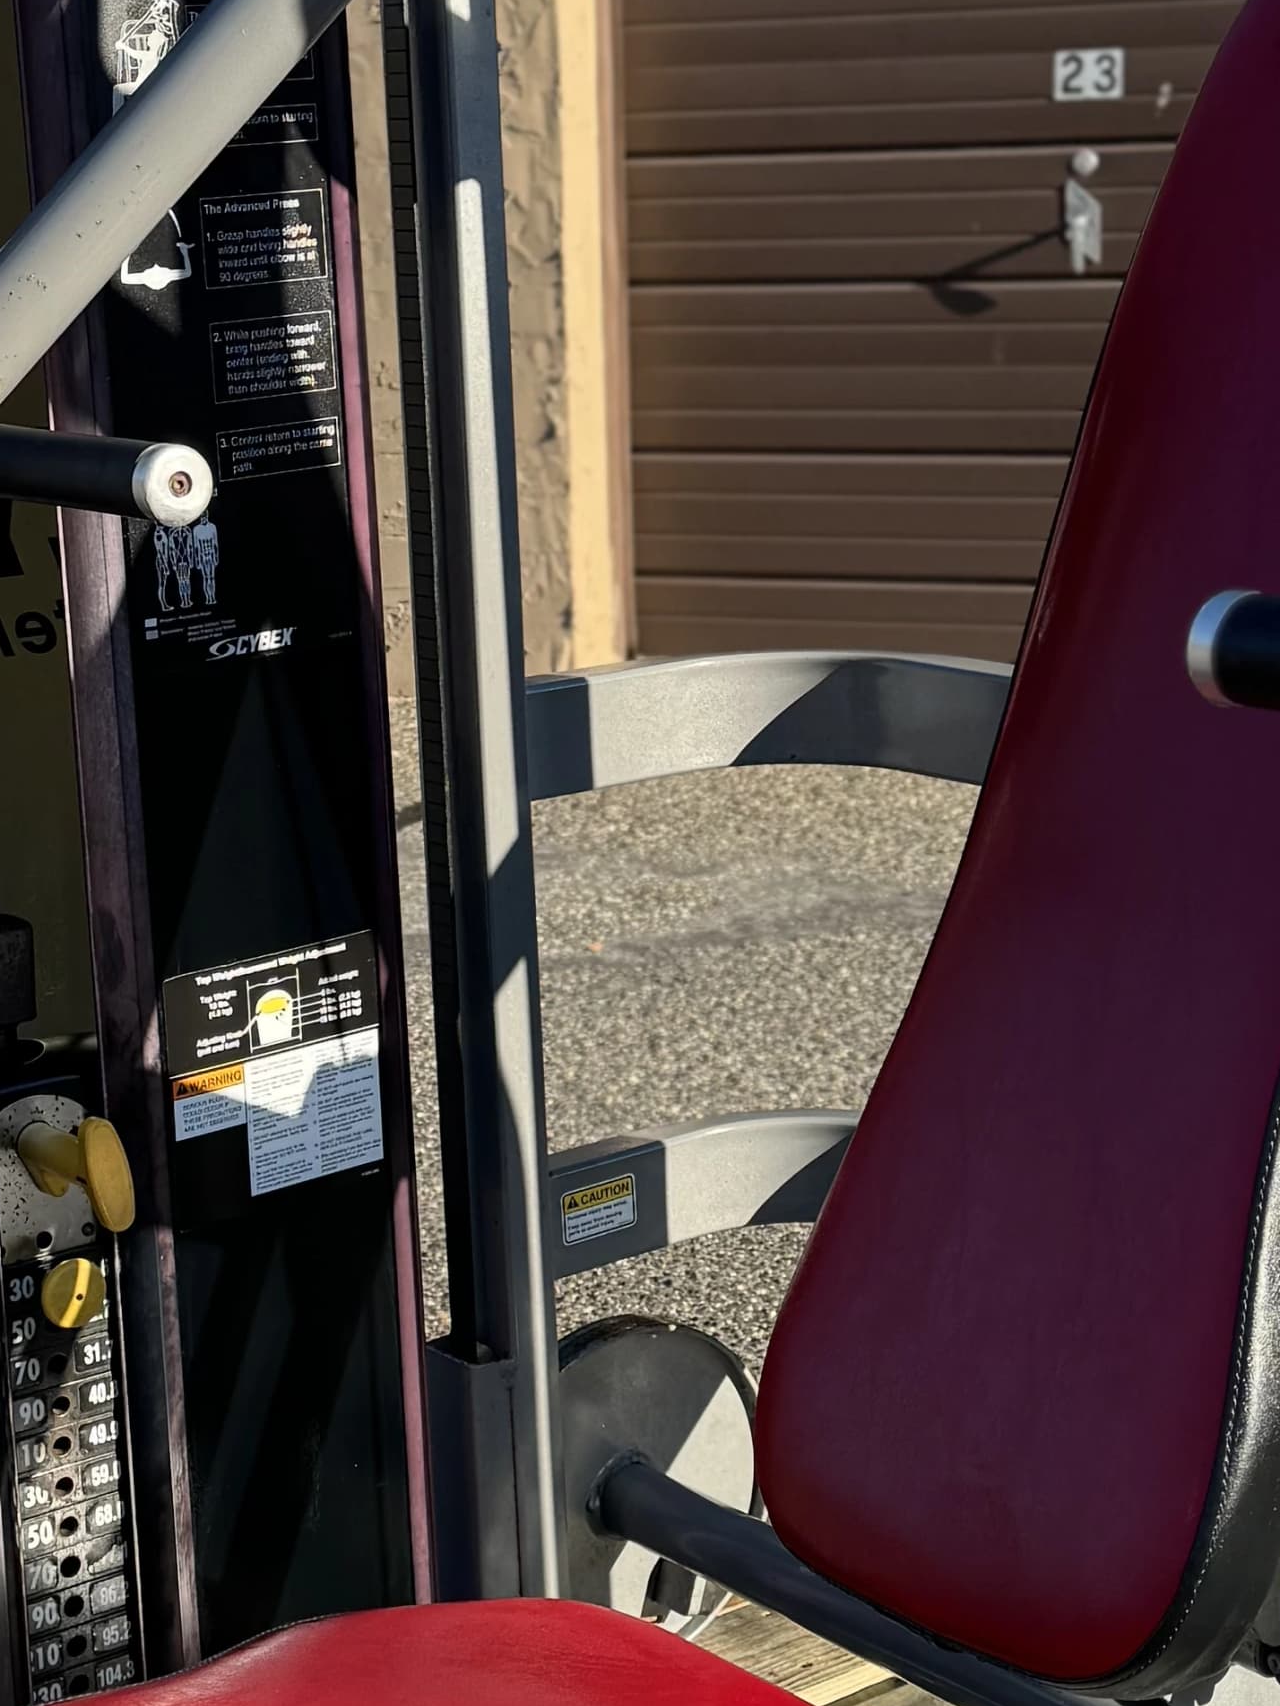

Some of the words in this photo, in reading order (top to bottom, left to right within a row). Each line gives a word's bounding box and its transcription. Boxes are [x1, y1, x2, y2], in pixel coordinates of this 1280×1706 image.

[1062, 53, 1116, 93] 23
[204, 204, 221, 215] The
[224, 201, 269, 213] Advanced
[273, 198, 300, 209] Press
[207, 232, 214, 242] 1.
[217, 231, 243, 242] Grasp
[213, 333, 222, 342] 2.
[236, 627, 294, 654] CYBEX
[189, 1071, 241, 1091] WARNING
[581, 1181, 629, 1204] CAUTION
[10, 1275, 34, 1301] 30
[11, 1317, 36, 1344] 50
[15, 1358, 40, 1385] 70
[20, 1399, 45, 1425] 90
[102, 1620, 131, 1646] 95.2
[97, 1661, 134, 1688] 104.3
